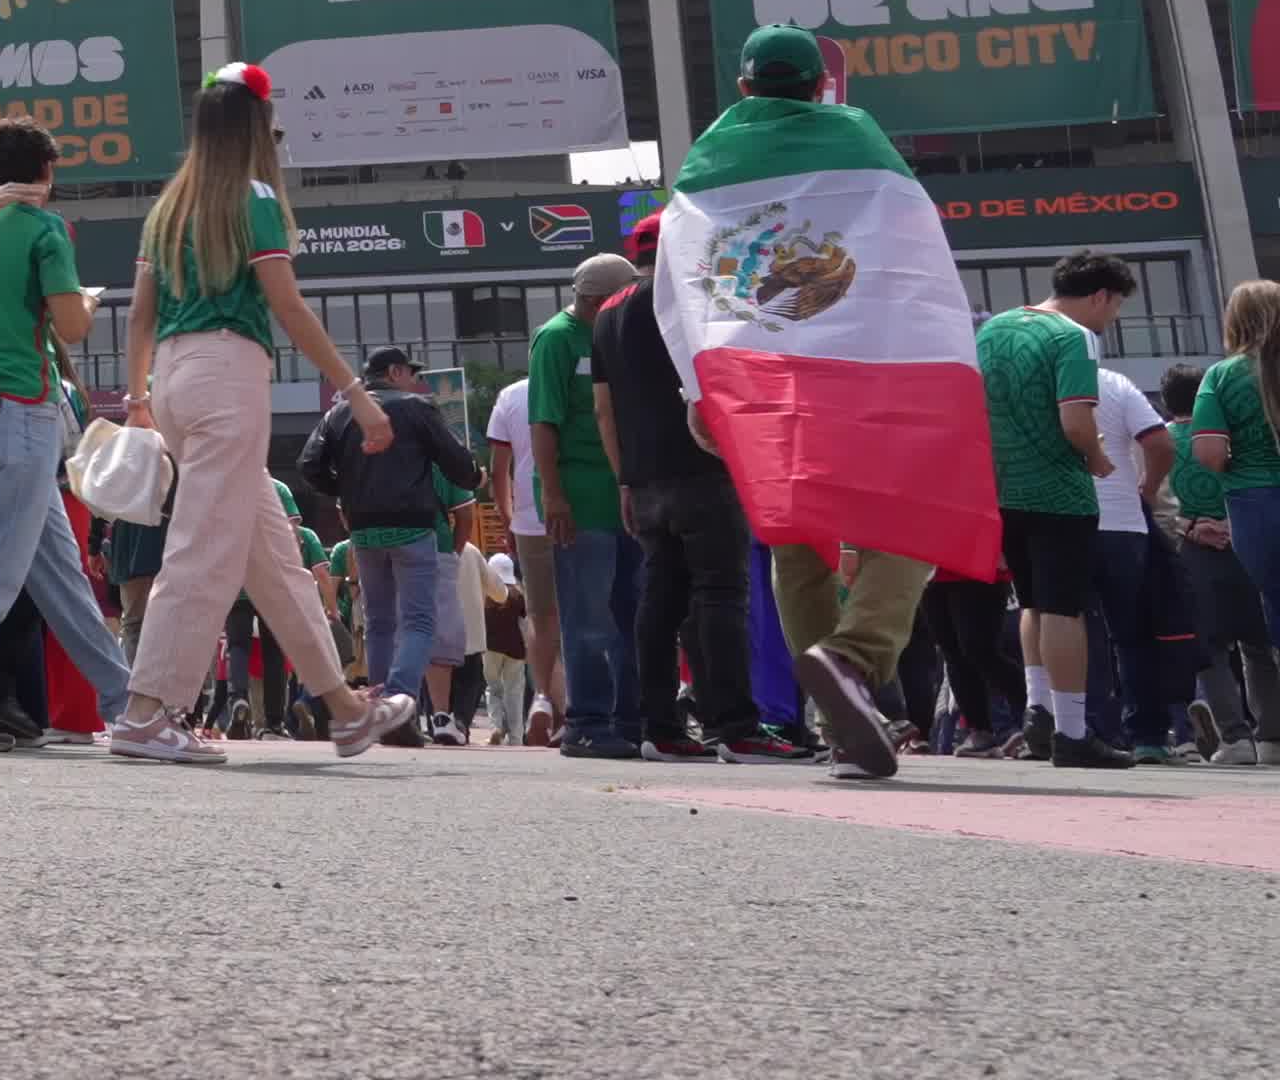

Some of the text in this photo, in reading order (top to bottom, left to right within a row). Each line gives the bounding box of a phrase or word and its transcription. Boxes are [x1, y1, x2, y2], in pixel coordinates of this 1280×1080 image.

[842, 21, 1096, 78] XICO CITY
[576, 68, 607, 80] VISA
[72, 93, 129, 128] DE
[980, 199, 1027, 218] DE
[1035, 190, 1180, 217] MÉXICO
[297, 224, 391, 241] PA MUNDIAL
[311, 241, 345, 254] FIFA
[346, 238, 402, 252] 2026
